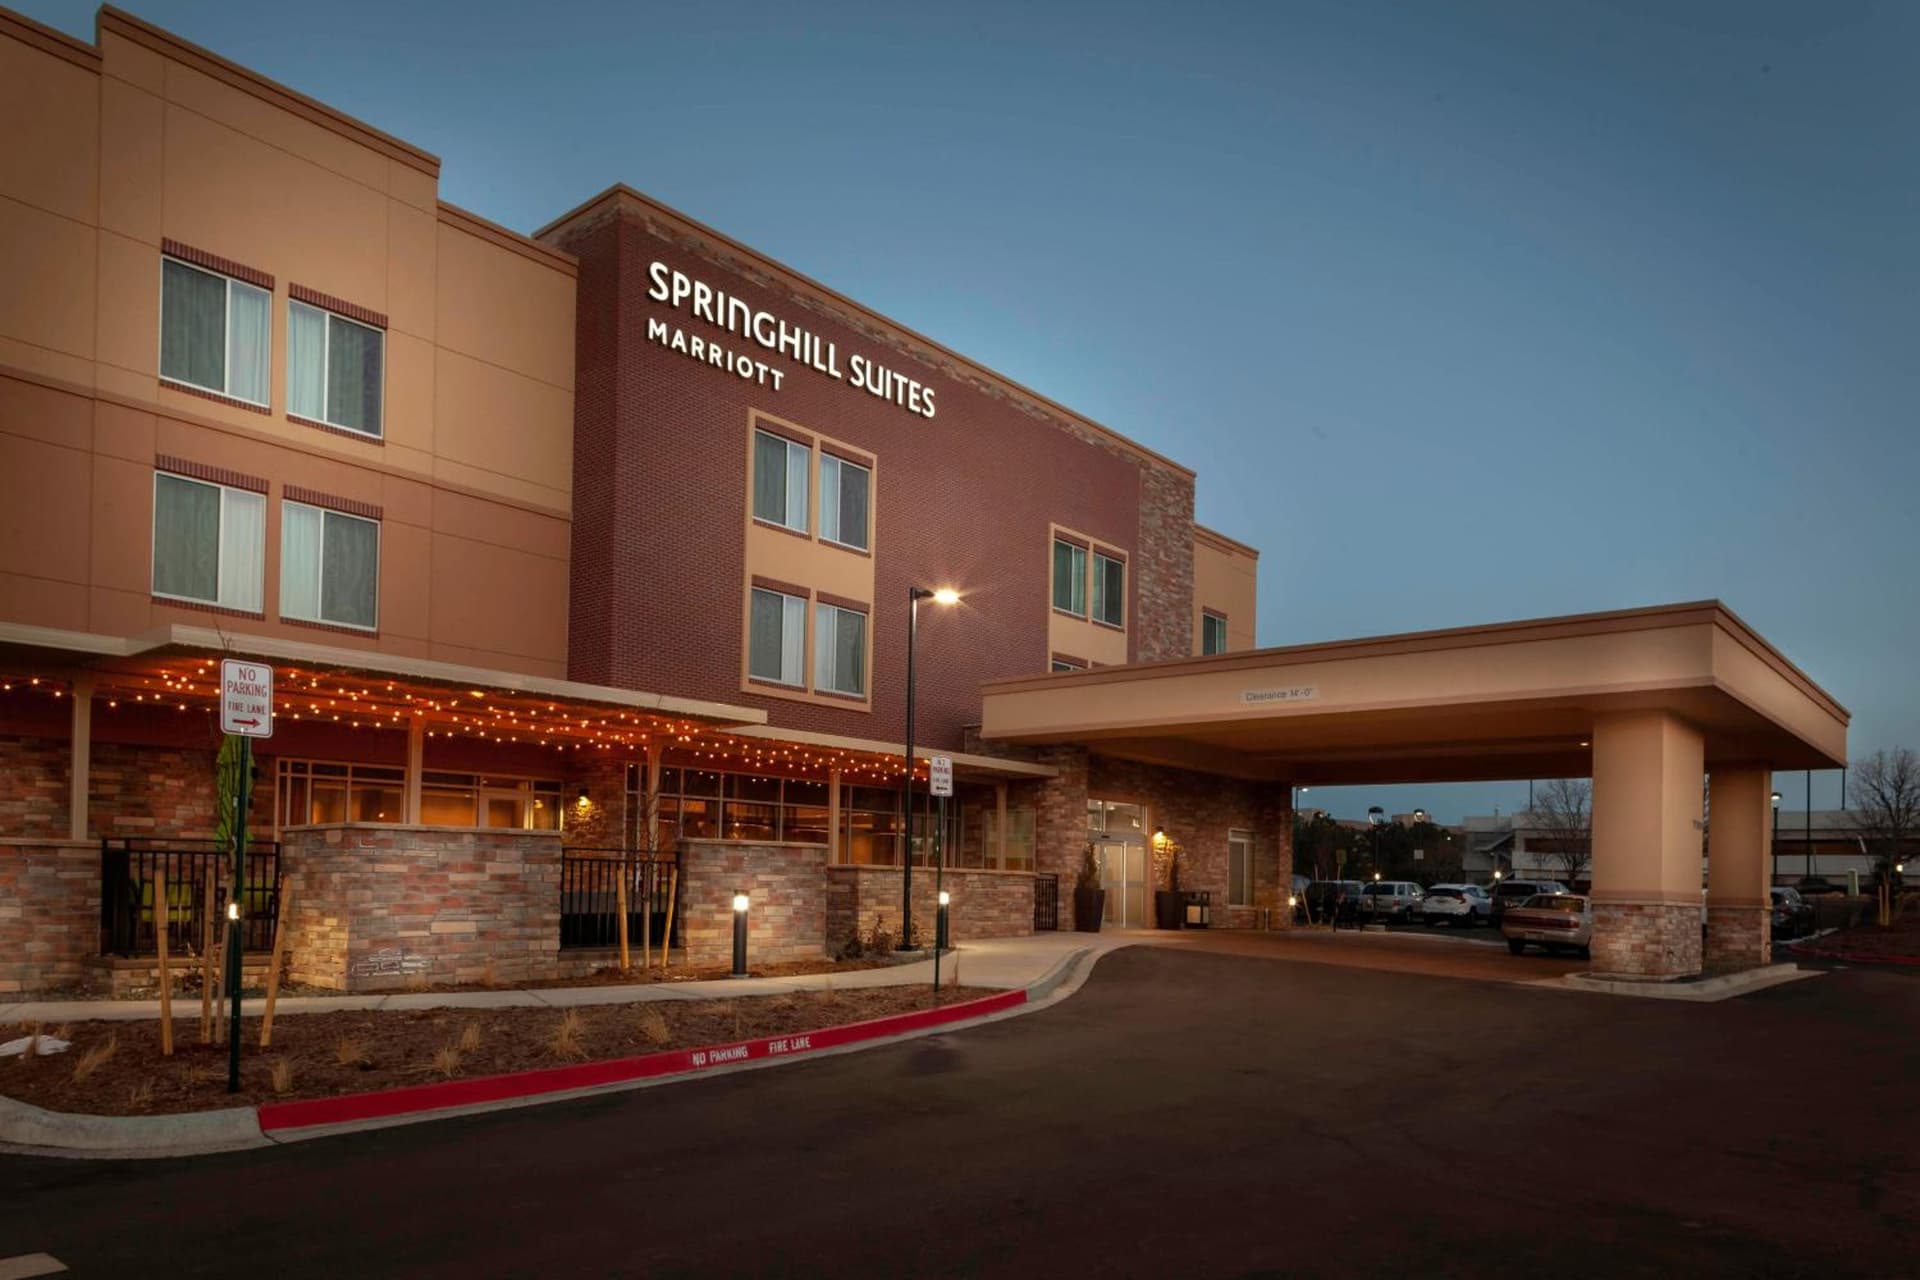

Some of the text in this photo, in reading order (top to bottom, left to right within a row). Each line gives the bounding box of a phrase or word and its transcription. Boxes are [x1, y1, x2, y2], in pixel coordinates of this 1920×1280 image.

[649, 261, 936, 418] SPRINGHILL SUITES
[648, 317, 785, 391] MARRIOTT
[238, 667, 257, 682] NO
[226, 680, 268, 698] PARKING
[228, 701, 266, 715] FIRE LANE
[692, 1036, 812, 1065] NO PARKING FIRE LANE
